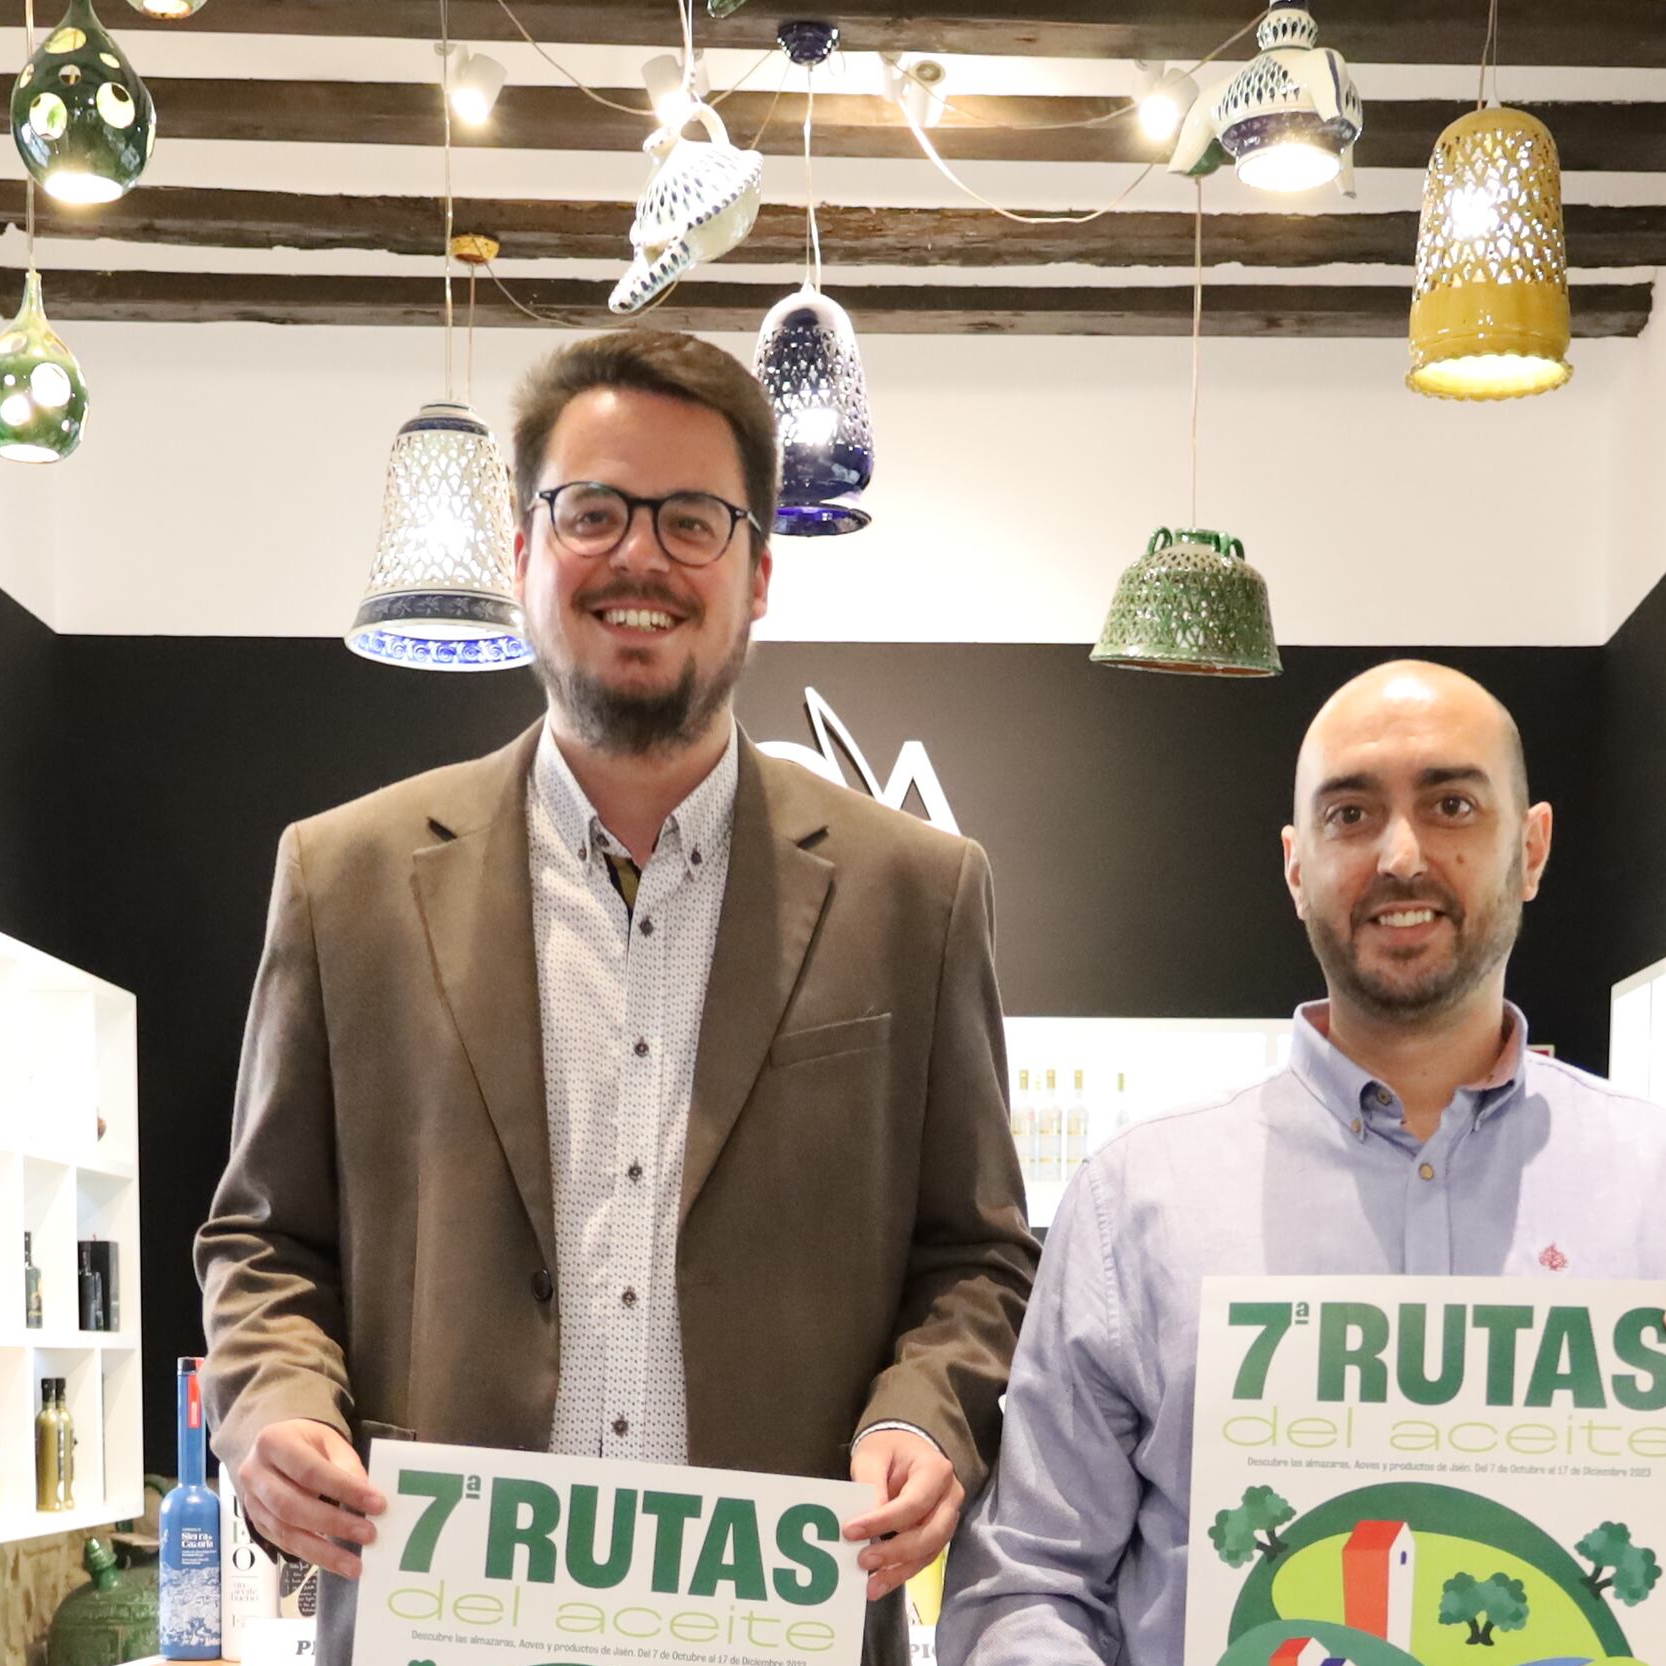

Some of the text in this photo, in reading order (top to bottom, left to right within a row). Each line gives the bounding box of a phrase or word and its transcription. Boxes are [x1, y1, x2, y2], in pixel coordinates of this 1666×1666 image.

[1228, 1301, 1309, 1401] 7ª
[1222, 1406, 1353, 1449] del
[1247, 1456, 1288, 1467] Descubre
[1290, 1457, 1303, 1468] las
[1389, 1461, 1434, 1473] productos
[1436, 1462, 1447, 1472] de
[1474, 1463, 1488, 1473] Del
[1497, 1464, 1508, 1474] de
[1510, 1464, 1546, 1475] Octubre
[1548, 1465, 1555, 1475] al
[1557, 1465, 1568, 1475] 17
[1570, 1465, 1581, 1476] de
[1583, 1466, 1628, 1477] Diciembre
[397, 1469, 841, 1606] 7ª RUTAS
[386, 1580, 836, 1652] del aceite
[411, 1630, 453, 1643] Descubre
[455, 1633, 468, 1645] las
[518, 1638, 545, 1650] Aoves
[554, 1643, 599, 1655] productos
[601, 1645, 611, 1655] de
[638, 1648, 651, 1659] Del
[660, 1650, 670, 1660] de
[672, 1652, 707, 1664] Octubre
[708, 1654, 716, 1664] al
[717, 1655, 727, 1665] 17
[730, 1656, 741, 1666] de
